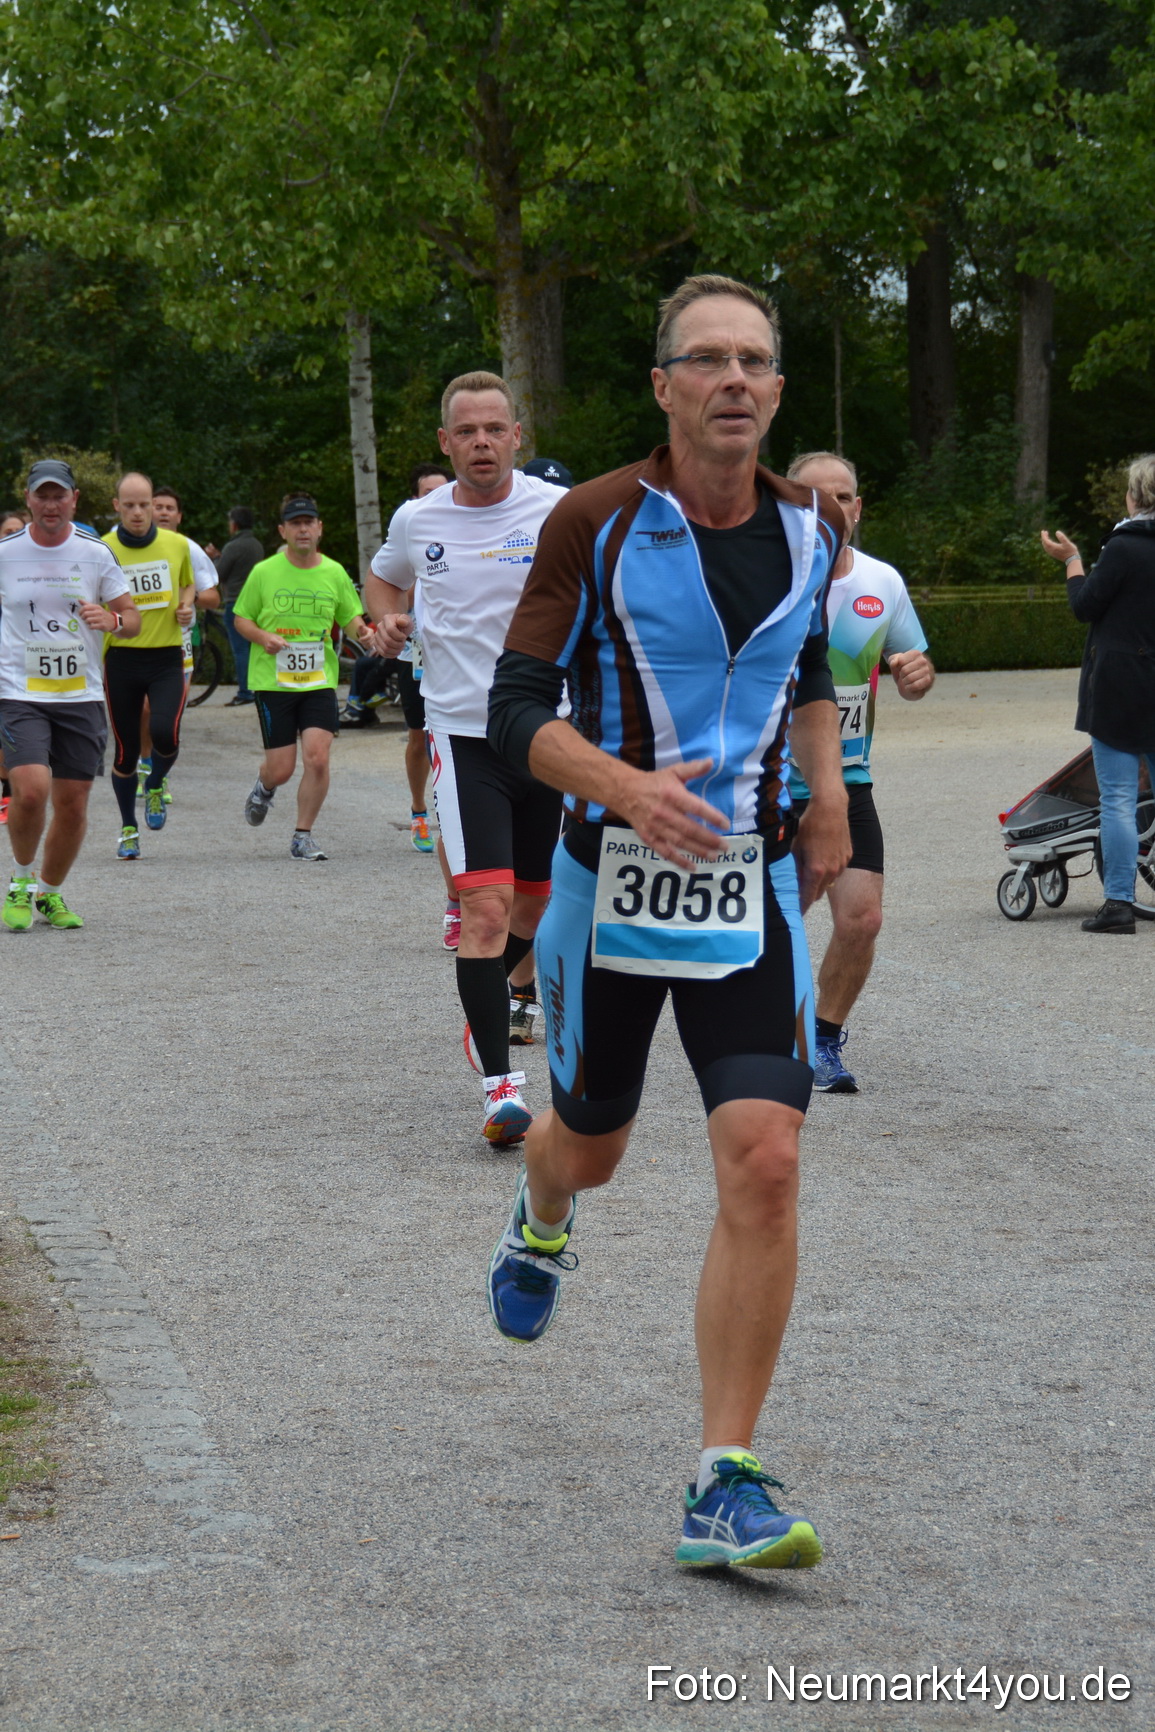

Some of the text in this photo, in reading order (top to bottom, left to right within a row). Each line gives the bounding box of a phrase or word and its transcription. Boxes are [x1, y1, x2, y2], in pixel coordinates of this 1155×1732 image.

[426, 561, 449, 572] PARTL
[427, 568, 450, 577] Neumarkt
[131, 573, 163, 593] 168
[134, 594, 164, 605] Christian
[273, 588, 334, 615] OPF
[857, 601, 881, 613] Hervis
[47, 620, 59, 632] G
[68, 618, 78, 633] G
[40, 654, 77, 676] 516
[287, 653, 315, 671] 351
[838, 704, 862, 736] 74
[606, 841, 660, 861] PARTL
[613, 864, 747, 924] 3058
